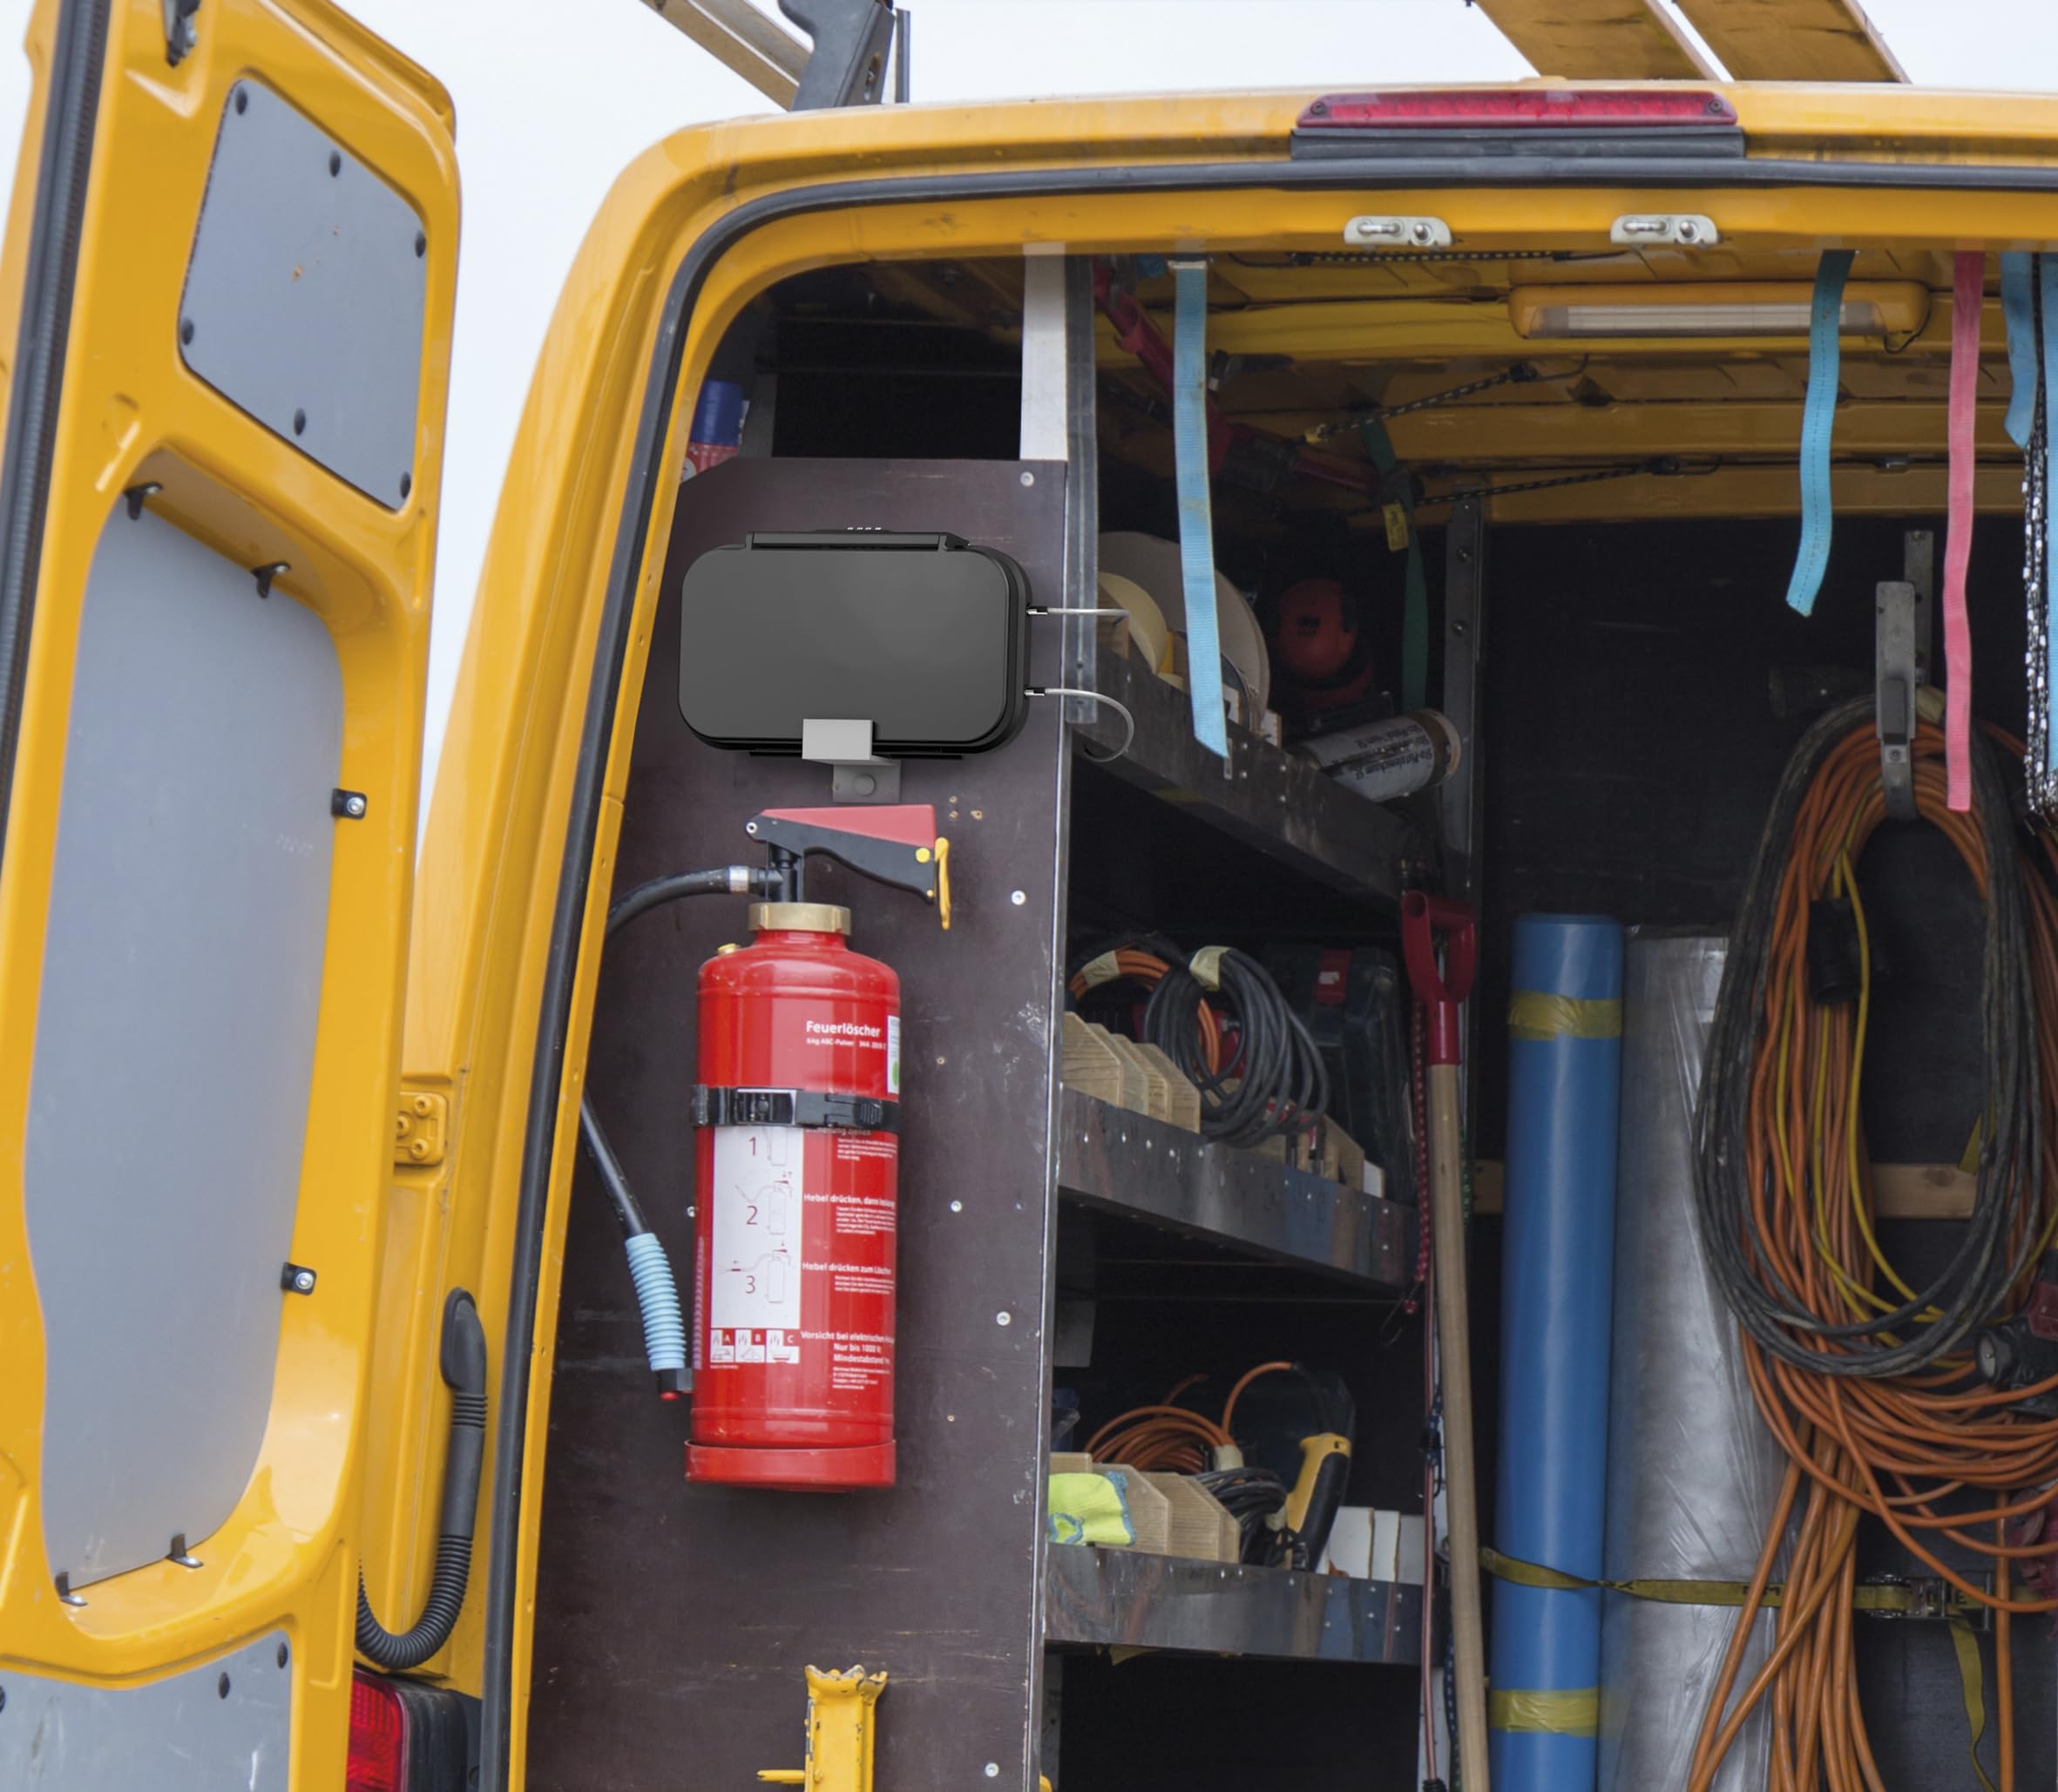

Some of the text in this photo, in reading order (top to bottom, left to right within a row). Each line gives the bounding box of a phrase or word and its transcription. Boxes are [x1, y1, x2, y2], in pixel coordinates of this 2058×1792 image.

[806, 1020, 881, 1037] Feuerlöscher
[748, 1137, 756, 1157] 1
[746, 1206, 758, 1226] 2
[802, 1262, 827, 1271] Hebel
[829, 1262, 859, 1273] drücken
[746, 1275, 755, 1294] 3
[725, 1334, 795, 1344] A B C
[801, 1331, 835, 1340] Vorsicht
[834, 1342, 848, 1351] Nur
[850, 1343, 860, 1352] bis
